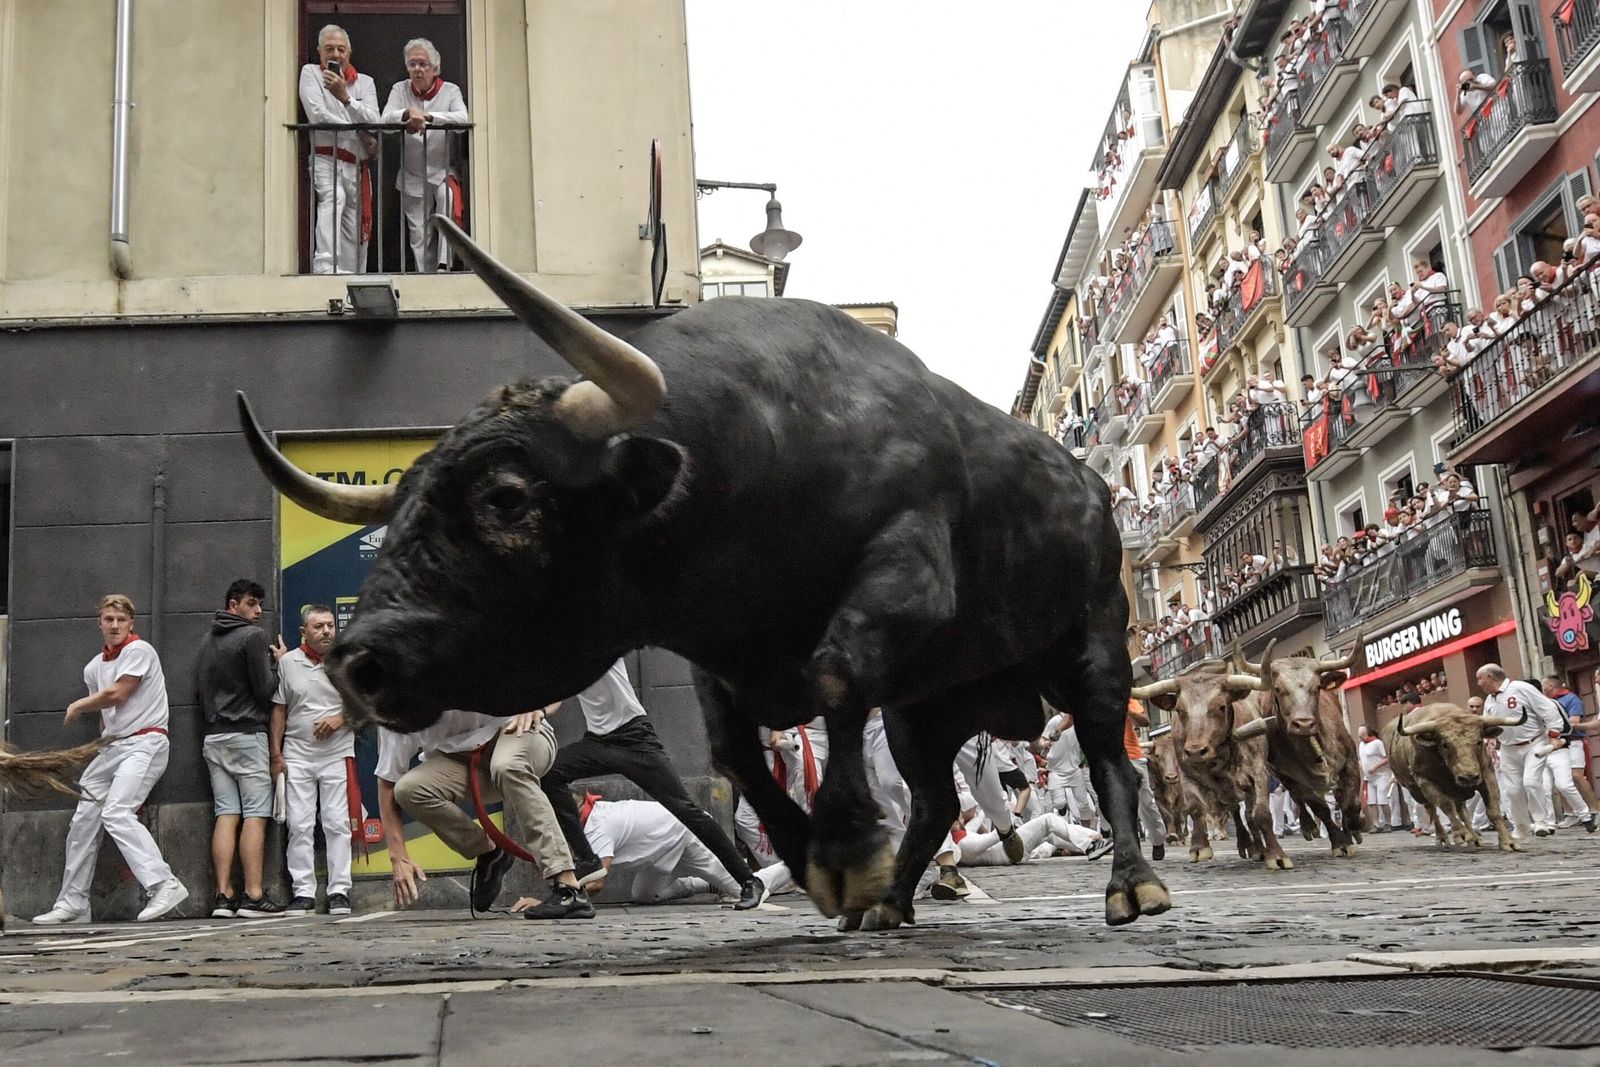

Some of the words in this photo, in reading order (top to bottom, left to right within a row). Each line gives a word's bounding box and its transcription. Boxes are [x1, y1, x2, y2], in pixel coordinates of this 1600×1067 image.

[1365, 625, 1421, 668] BURGER
[1420, 608, 1462, 647] KING
[1507, 696, 1518, 709] 6
